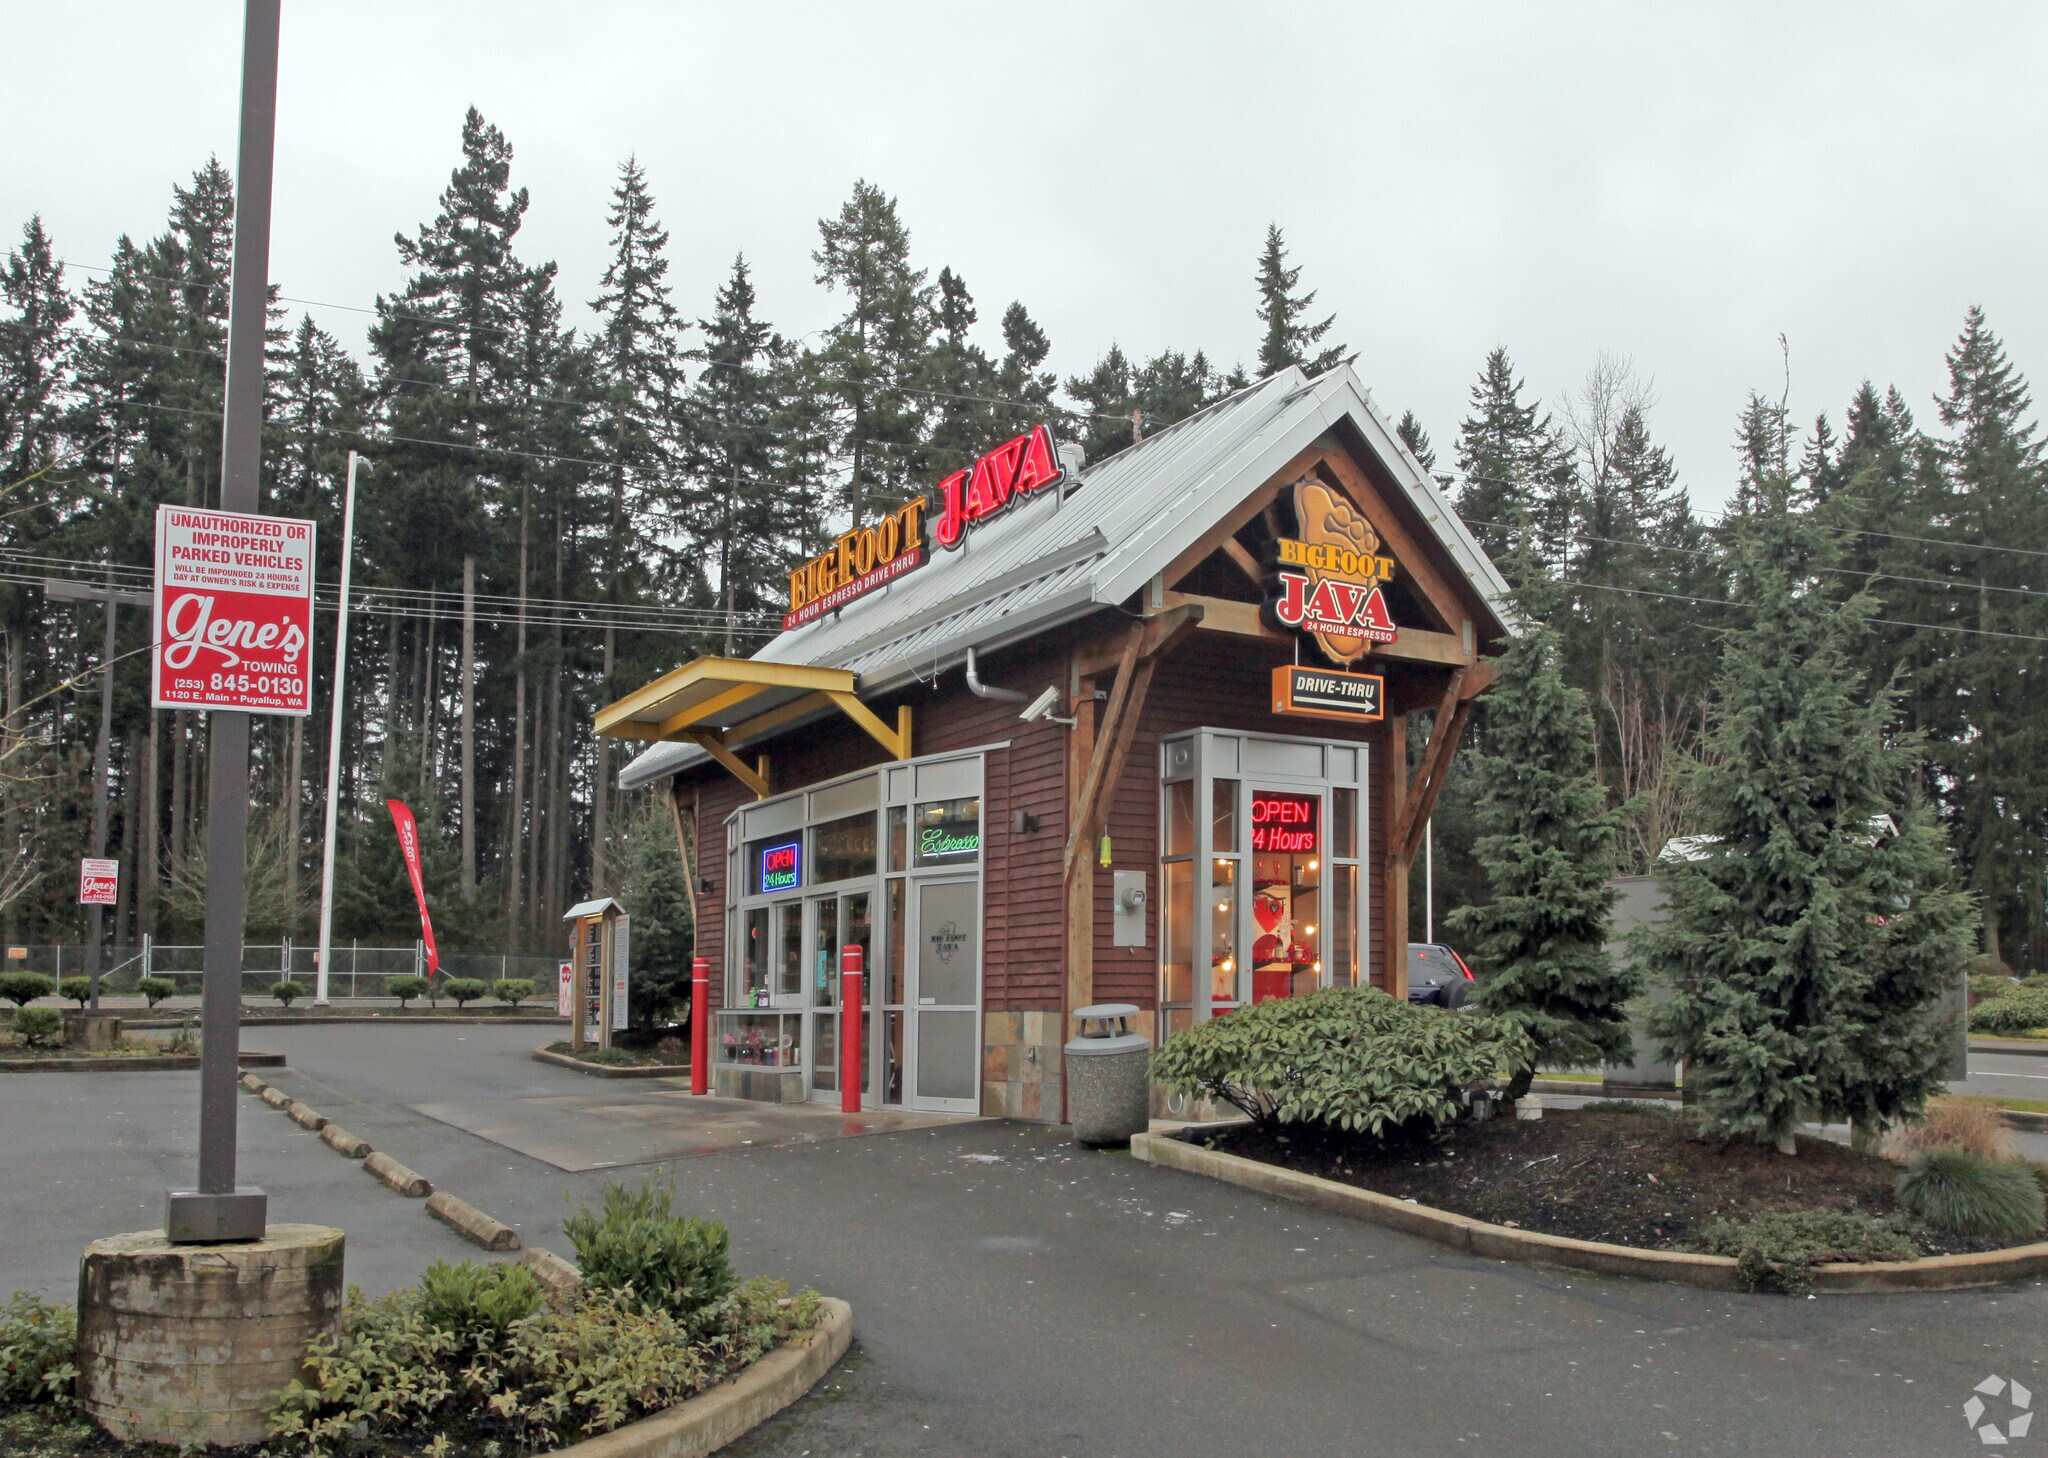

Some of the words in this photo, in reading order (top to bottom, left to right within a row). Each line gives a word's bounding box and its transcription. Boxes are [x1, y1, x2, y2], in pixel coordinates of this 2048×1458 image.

[936, 424, 1058, 545] JAVA
[171, 513, 282, 537] UNAUTHORIZED
[286, 525, 306, 539] OR
[192, 531, 285, 553] IMPROPERLY
[172, 545, 231, 564] PARKED
[235, 551, 303, 571] VEHICLES
[788, 496, 926, 613] BIGFOOT
[1278, 538, 1394, 580] BIGFOOT
[173, 573, 188, 581] DAY
[202, 576, 237, 586] OWNER'S
[240, 580, 257, 588] RISK
[267, 582, 300, 592] EXPENSE
[175, 564, 193, 573] WILL
[196, 566, 206, 574] BE
[208, 567, 253, 579] IMPOUNDED
[256, 572, 265, 580] 24
[267, 573, 292, 581] HOURS
[787, 616, 797, 627] 24
[799, 604, 820, 621] HOUR
[822, 582, 863, 609] ESPRESSO
[864, 566, 890, 588] DRIVE
[891, 552, 915, 575] THRU
[1277, 573, 1395, 631] JAVA
[164, 593, 305, 670] Gene's
[1307, 621, 1318, 631] 24
[1320, 624, 1345, 635] HOUR
[1347, 627, 1393, 642] ESPRESSO
[241, 660, 298, 674] TOWING
[174, 678, 205, 691] (253)
[210, 673, 304, 696] 845-0130
[1296, 676, 1375, 698] DRIVE-THRU
[165, 690, 190, 699] 1120
[192, 692, 203, 700] E.
[205, 693, 230, 702] Main
[240, 694, 284, 706] Puyallup,
[287, 698, 303, 706] WA
[1251, 800, 1309, 823] OPEN
[921, 828, 979, 858] Espresso
[1267, 826, 1314, 852] Hours
[767, 849, 794, 870] OPEN
[775, 872, 795, 886] Hours
